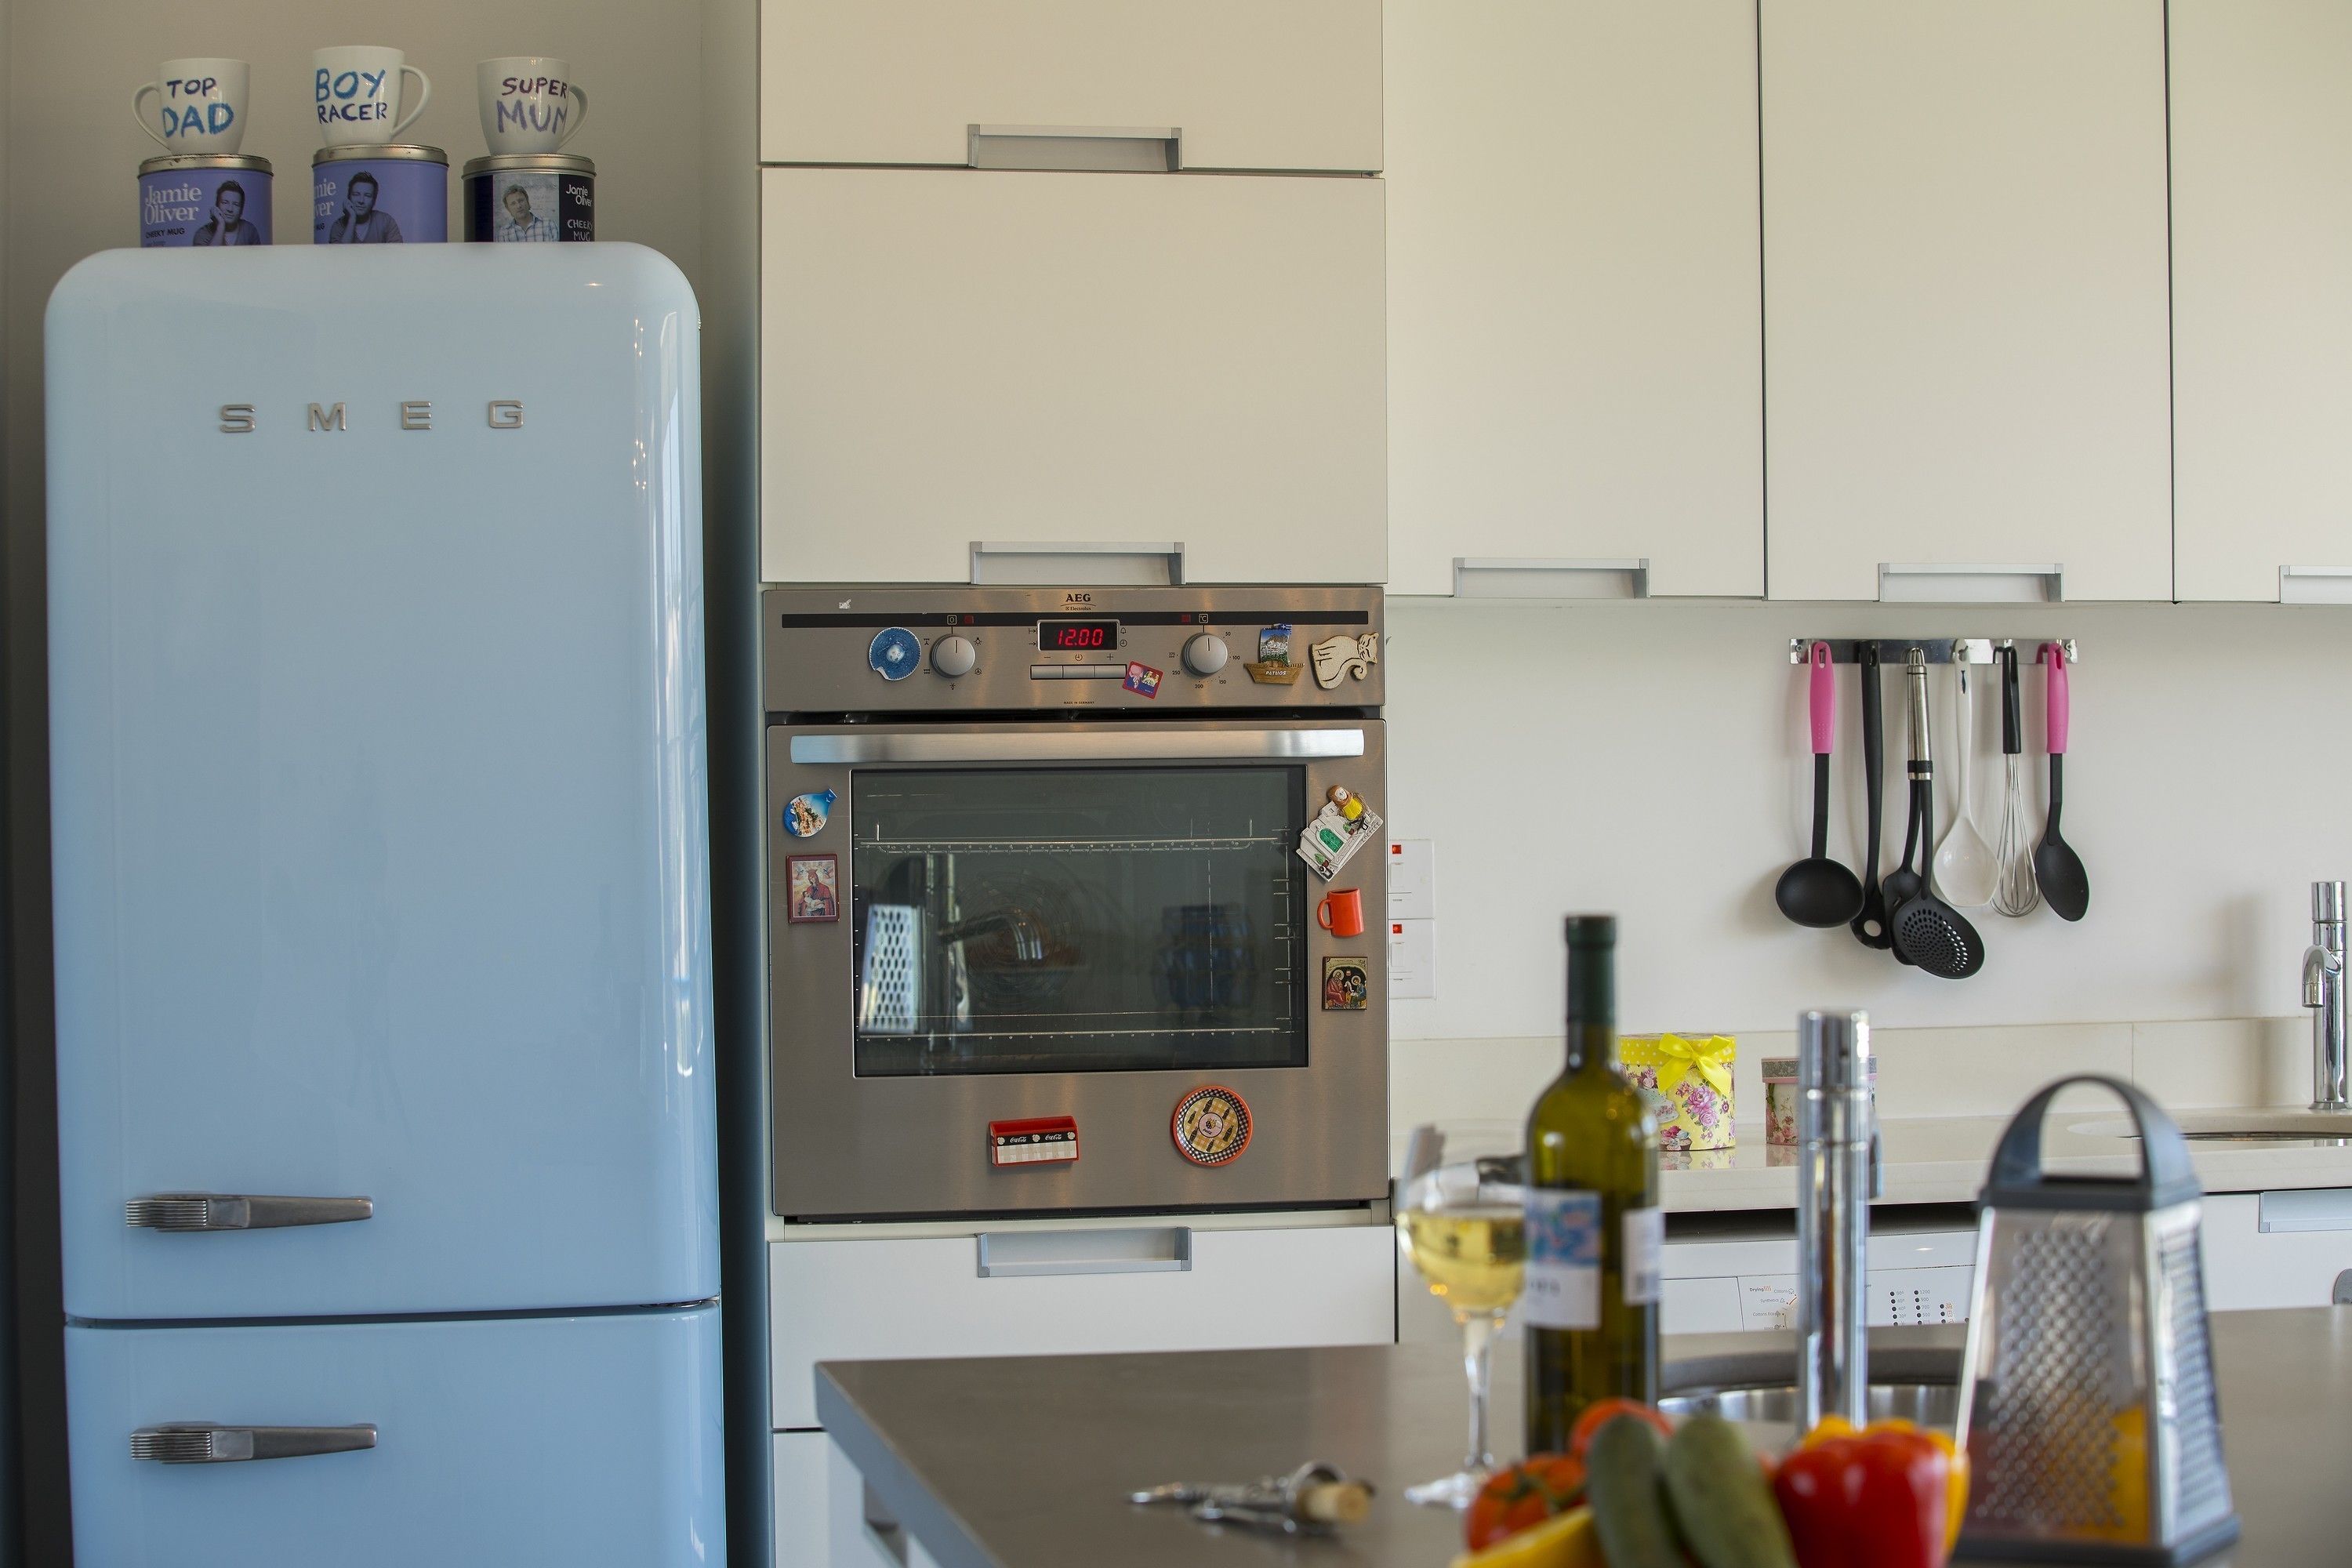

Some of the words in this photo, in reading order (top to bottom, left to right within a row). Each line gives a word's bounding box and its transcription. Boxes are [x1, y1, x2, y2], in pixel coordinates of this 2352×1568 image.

[166, 77, 216, 99] TOP
[316, 68, 386, 103] BOY
[502, 77, 568, 99] SUPER
[162, 103, 234, 138] DAD
[318, 102, 388, 125] RACER
[145, 183, 202, 205] Jamie
[566, 184, 588, 197] Jamie
[144, 205, 201, 225] Oliver
[167, 227, 185, 236] MUG
[220, 400, 524, 433] SMEG
[1065, 593, 1091, 602] AEG
